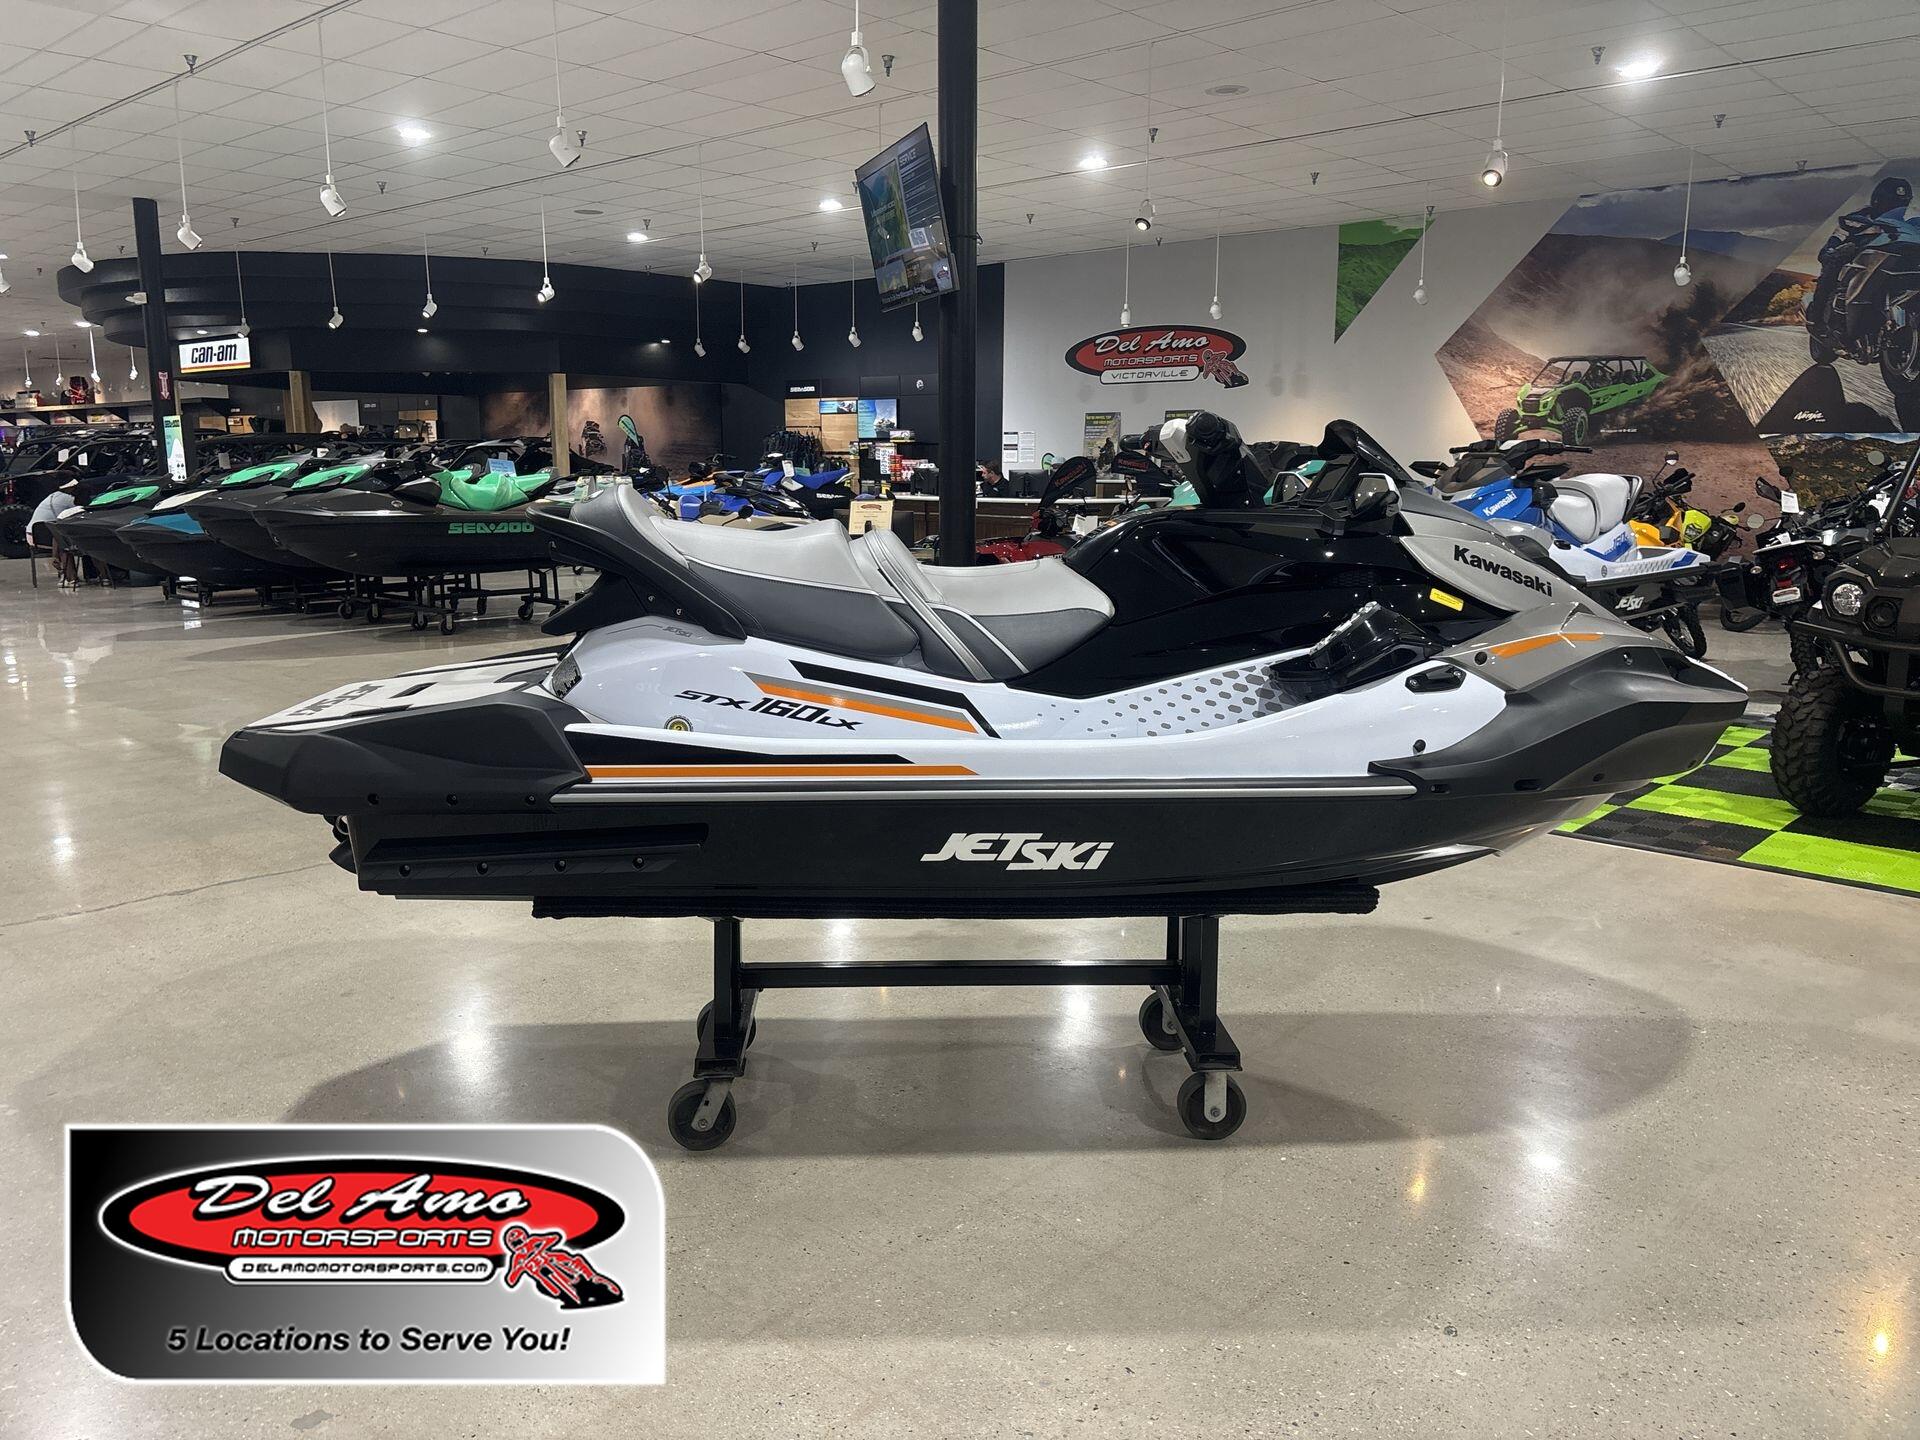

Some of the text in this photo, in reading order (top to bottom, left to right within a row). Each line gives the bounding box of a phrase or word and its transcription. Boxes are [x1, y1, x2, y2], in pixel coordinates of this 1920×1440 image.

[1095, 331, 1209, 353] Del Amo
[1103, 354, 1199, 367] MOTORSPORTS
[1110, 369, 1190, 380] VICTORVILLE
[1793, 410, 1824, 422] Ninja
[1482, 489, 1517, 517] Kawasaki
[1453, 544, 1553, 597] Kawasaki
